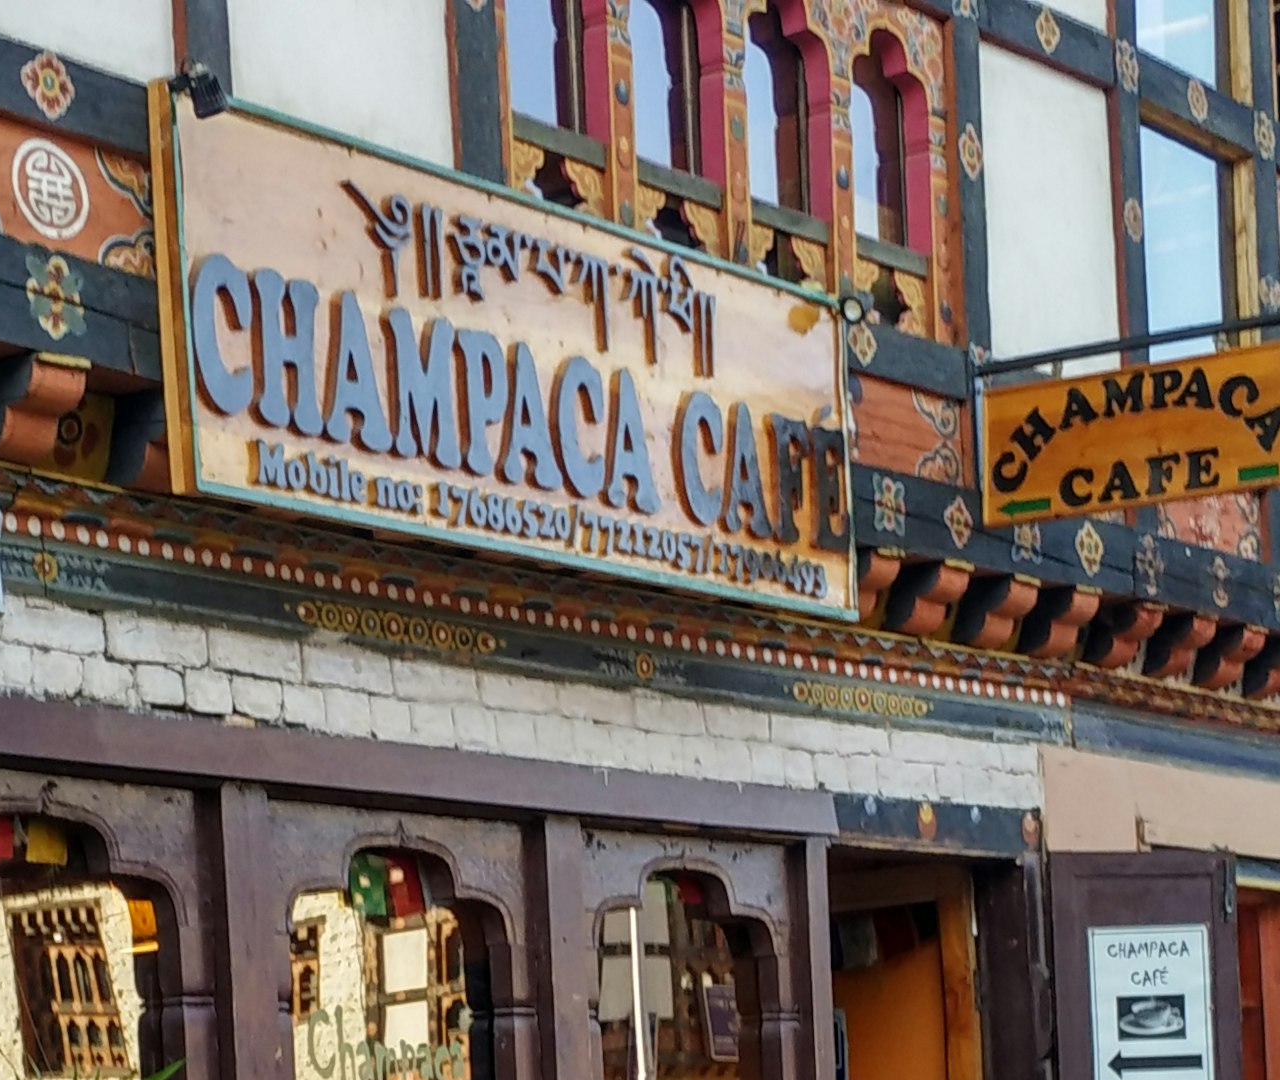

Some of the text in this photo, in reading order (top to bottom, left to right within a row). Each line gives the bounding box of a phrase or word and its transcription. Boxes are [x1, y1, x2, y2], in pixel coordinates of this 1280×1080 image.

[191, 251, 660, 514] CHAMPACA
[248, 439, 366, 502] Mobile
[371, 475, 424, 516] no:
[1058, 446, 1220, 508] CAFE
[1107, 940, 1190, 960] CHAMPACA
